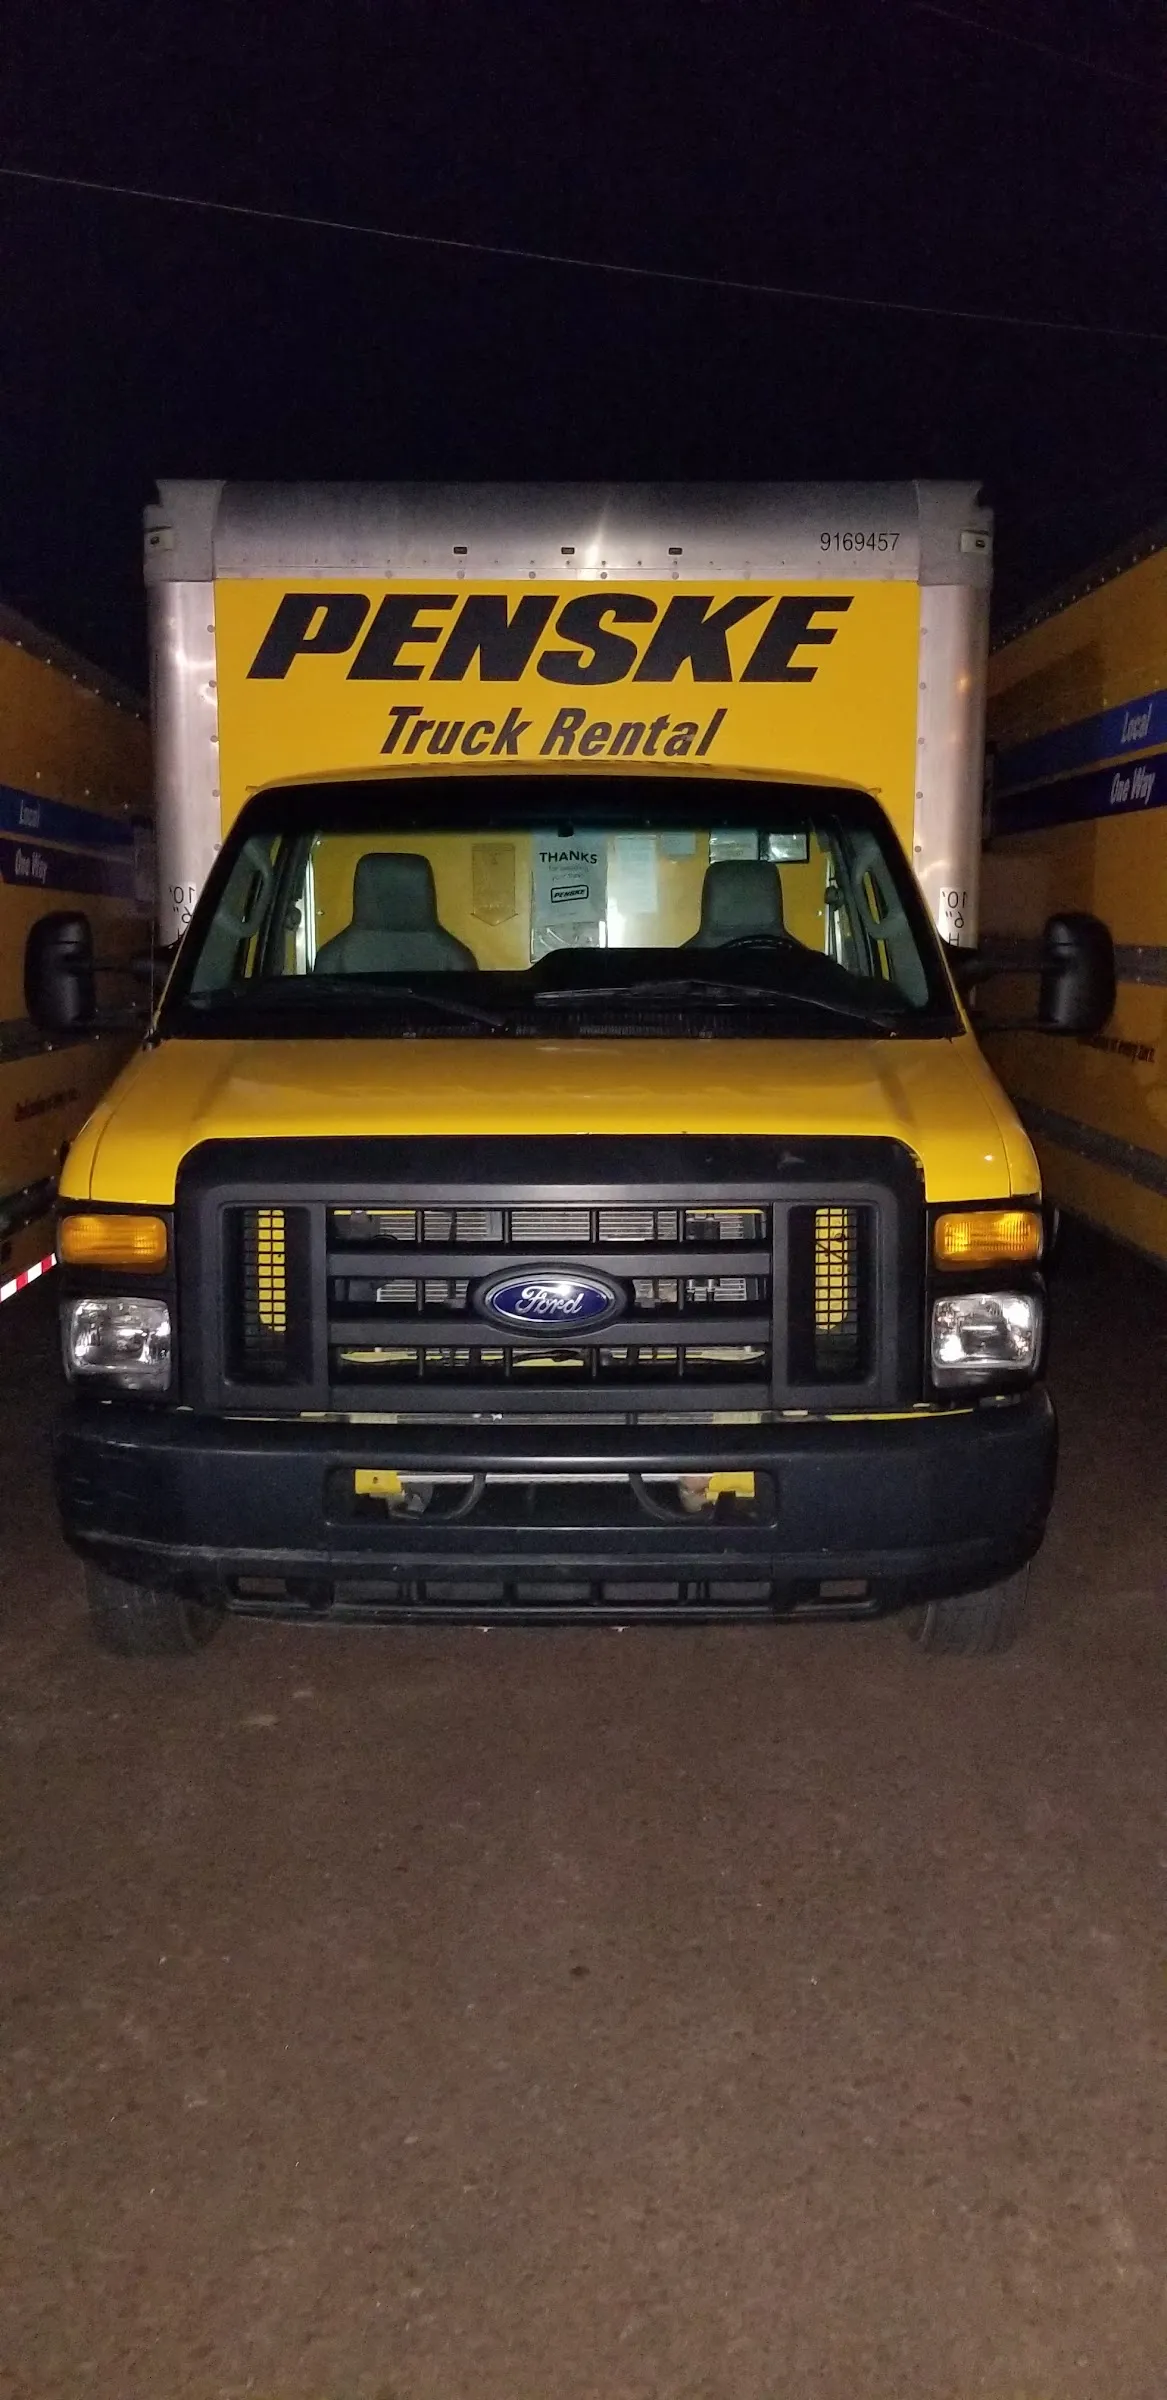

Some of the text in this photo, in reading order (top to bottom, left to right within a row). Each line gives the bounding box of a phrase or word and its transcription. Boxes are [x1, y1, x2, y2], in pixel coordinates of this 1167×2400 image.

[820, 532, 900, 552] 9169457
[247, 592, 854, 686] PENSKE
[380, 706, 729, 757] Truck Rental
[1121, 703, 1152, 743] Local
[1110, 765, 1156, 805] One Way
[539, 850, 598, 865] THANKS
[554, 890, 585, 898] PENSKE
[515, 1285, 585, 1315] Ford
